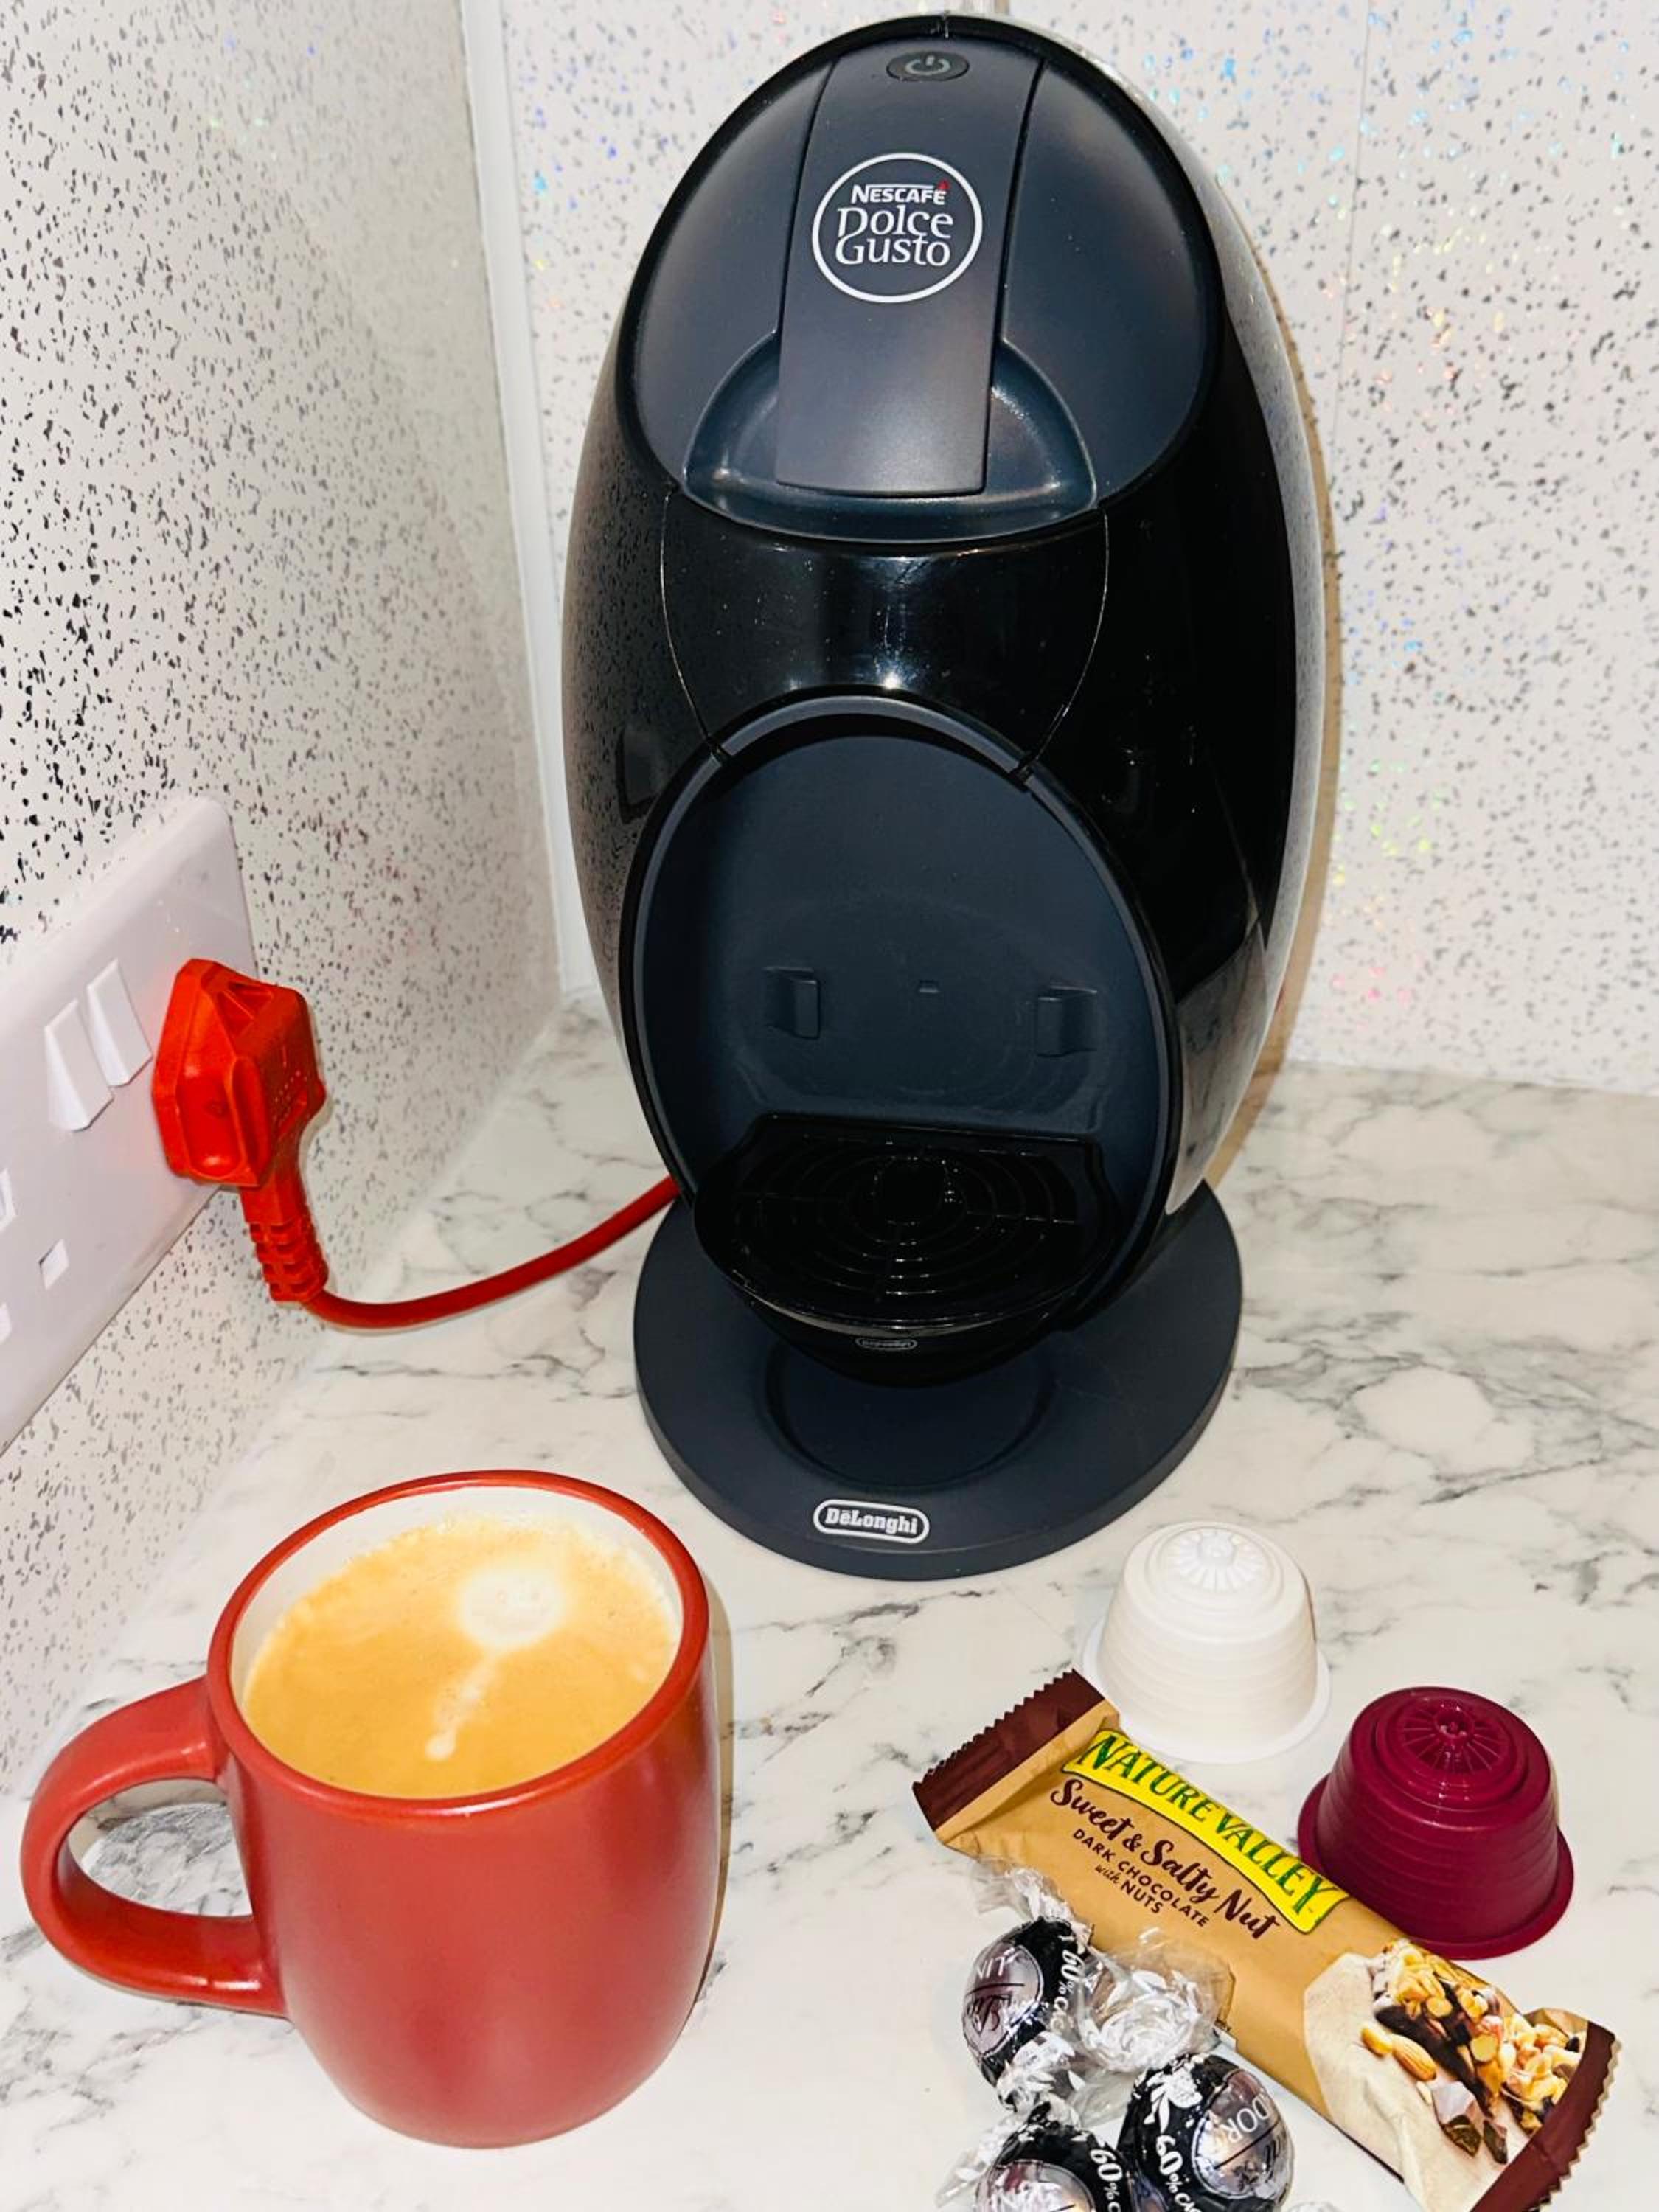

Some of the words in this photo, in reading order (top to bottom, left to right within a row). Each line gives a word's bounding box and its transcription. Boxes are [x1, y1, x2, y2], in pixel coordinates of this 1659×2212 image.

[837, 204, 953, 239] Dolce
[835, 236, 950, 266] Gusto
[825, 1508, 917, 1534] DeLonghi
[1077, 1735, 1222, 1822] NATURE
[1216, 1812, 1339, 1914] VALLEY
[1050, 1778, 1134, 1841] Sweet
[1122, 1834, 1142, 1852] &
[1140, 1840, 1220, 1904] Salty
[1213, 1888, 1280, 1939] Nut
[1073, 1829, 1116, 1862] DARK
[1118, 1860, 1209, 1927] CHOCOLATE
[1095, 1864, 1121, 1884] with
[1121, 1880, 1164, 1913] NUTS
[1058, 1949, 1086, 1994] 60%
[1090, 2149, 1123, 2200] 60%
[1155, 2135, 1183, 2194] 60%
